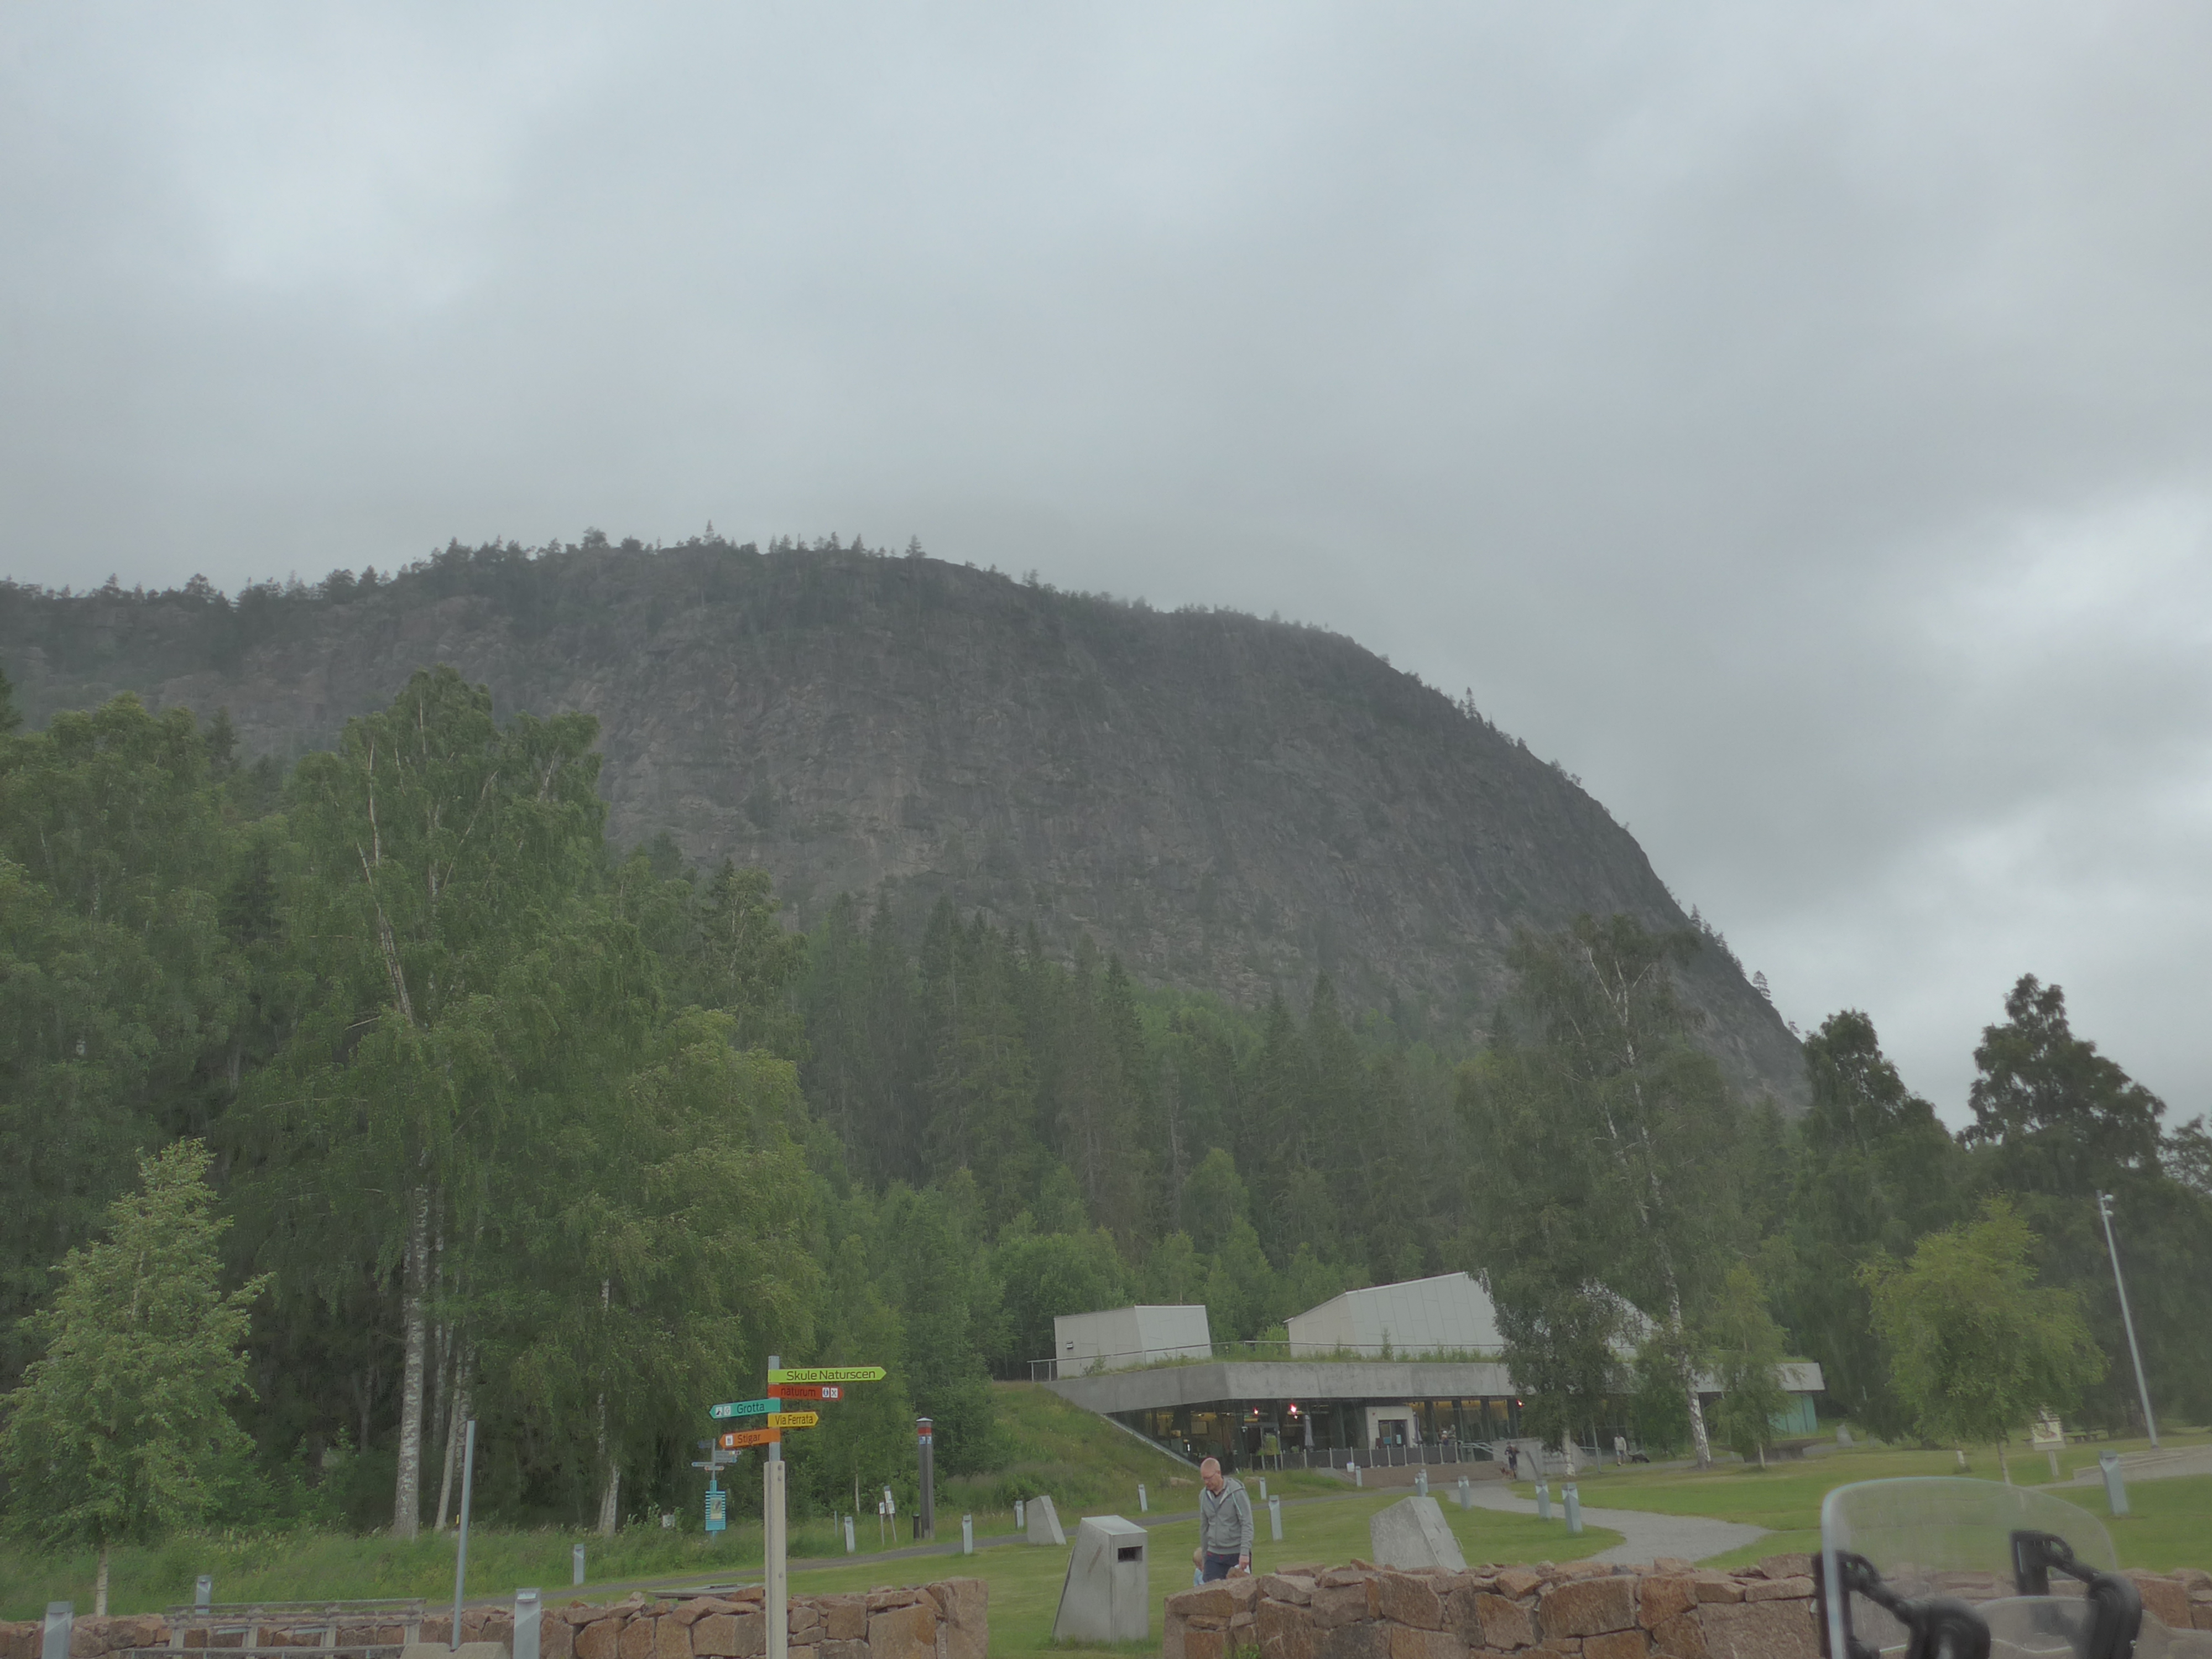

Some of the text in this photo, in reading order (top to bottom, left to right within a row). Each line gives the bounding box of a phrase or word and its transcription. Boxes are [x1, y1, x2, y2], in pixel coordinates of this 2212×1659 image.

[786, 1370, 875, 1381] Skule Naturscen
[781, 1387, 816, 1396] naturum
[737, 1402, 765, 1414] Grotta
[775, 1415, 813, 1425] Via Ferrata
[738, 1433, 761, 1444] Stigar
